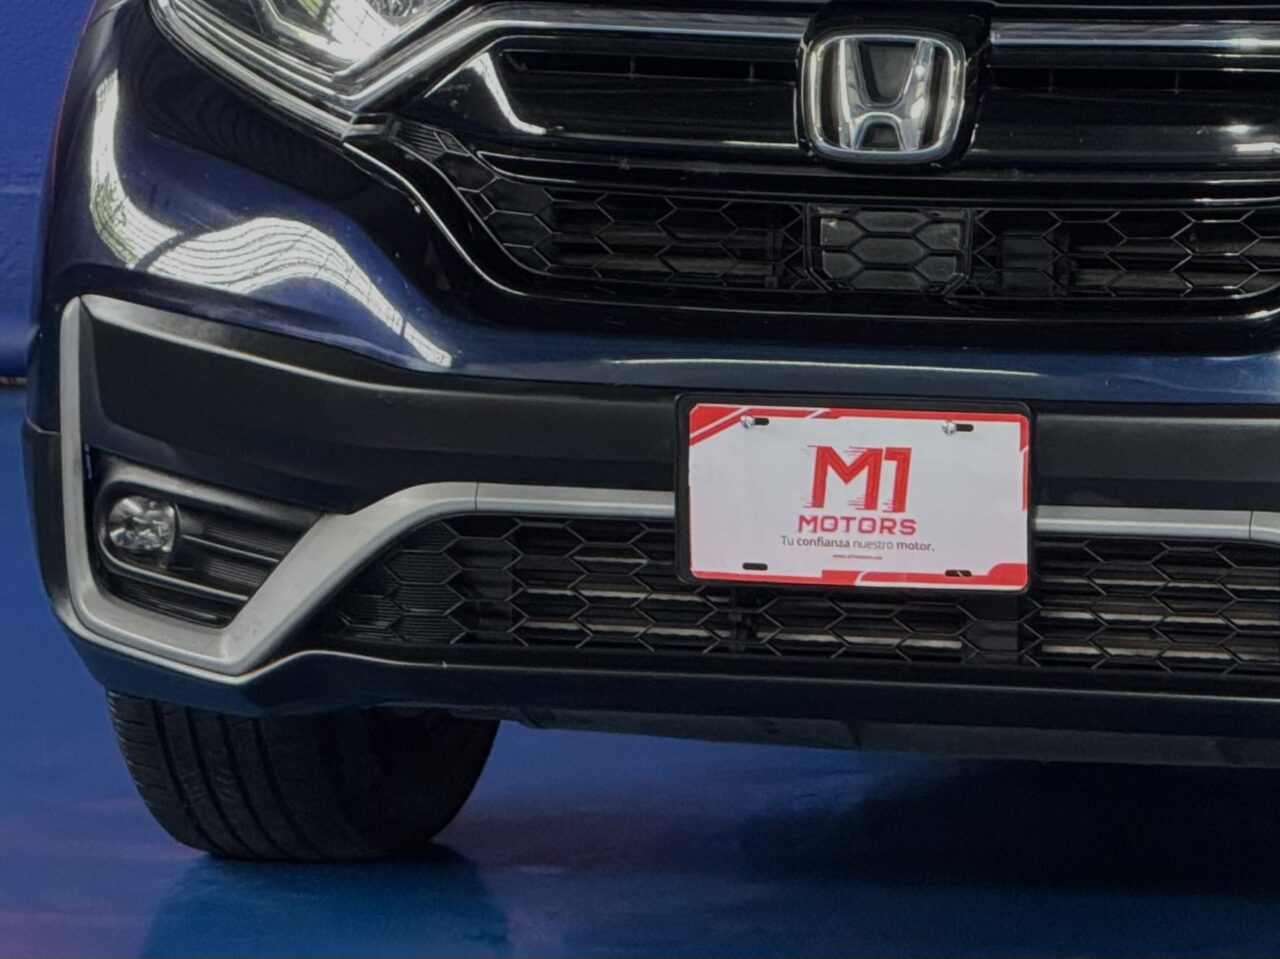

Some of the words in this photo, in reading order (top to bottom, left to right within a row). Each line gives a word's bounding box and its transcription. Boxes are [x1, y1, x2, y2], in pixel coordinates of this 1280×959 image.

[798, 514, 918, 536] MOTORS
[780, 535, 794, 546] Tu
[796, 536, 851, 549] confianza
[853, 539, 894, 551] nuestro
[896, 541, 935, 552] motor.
